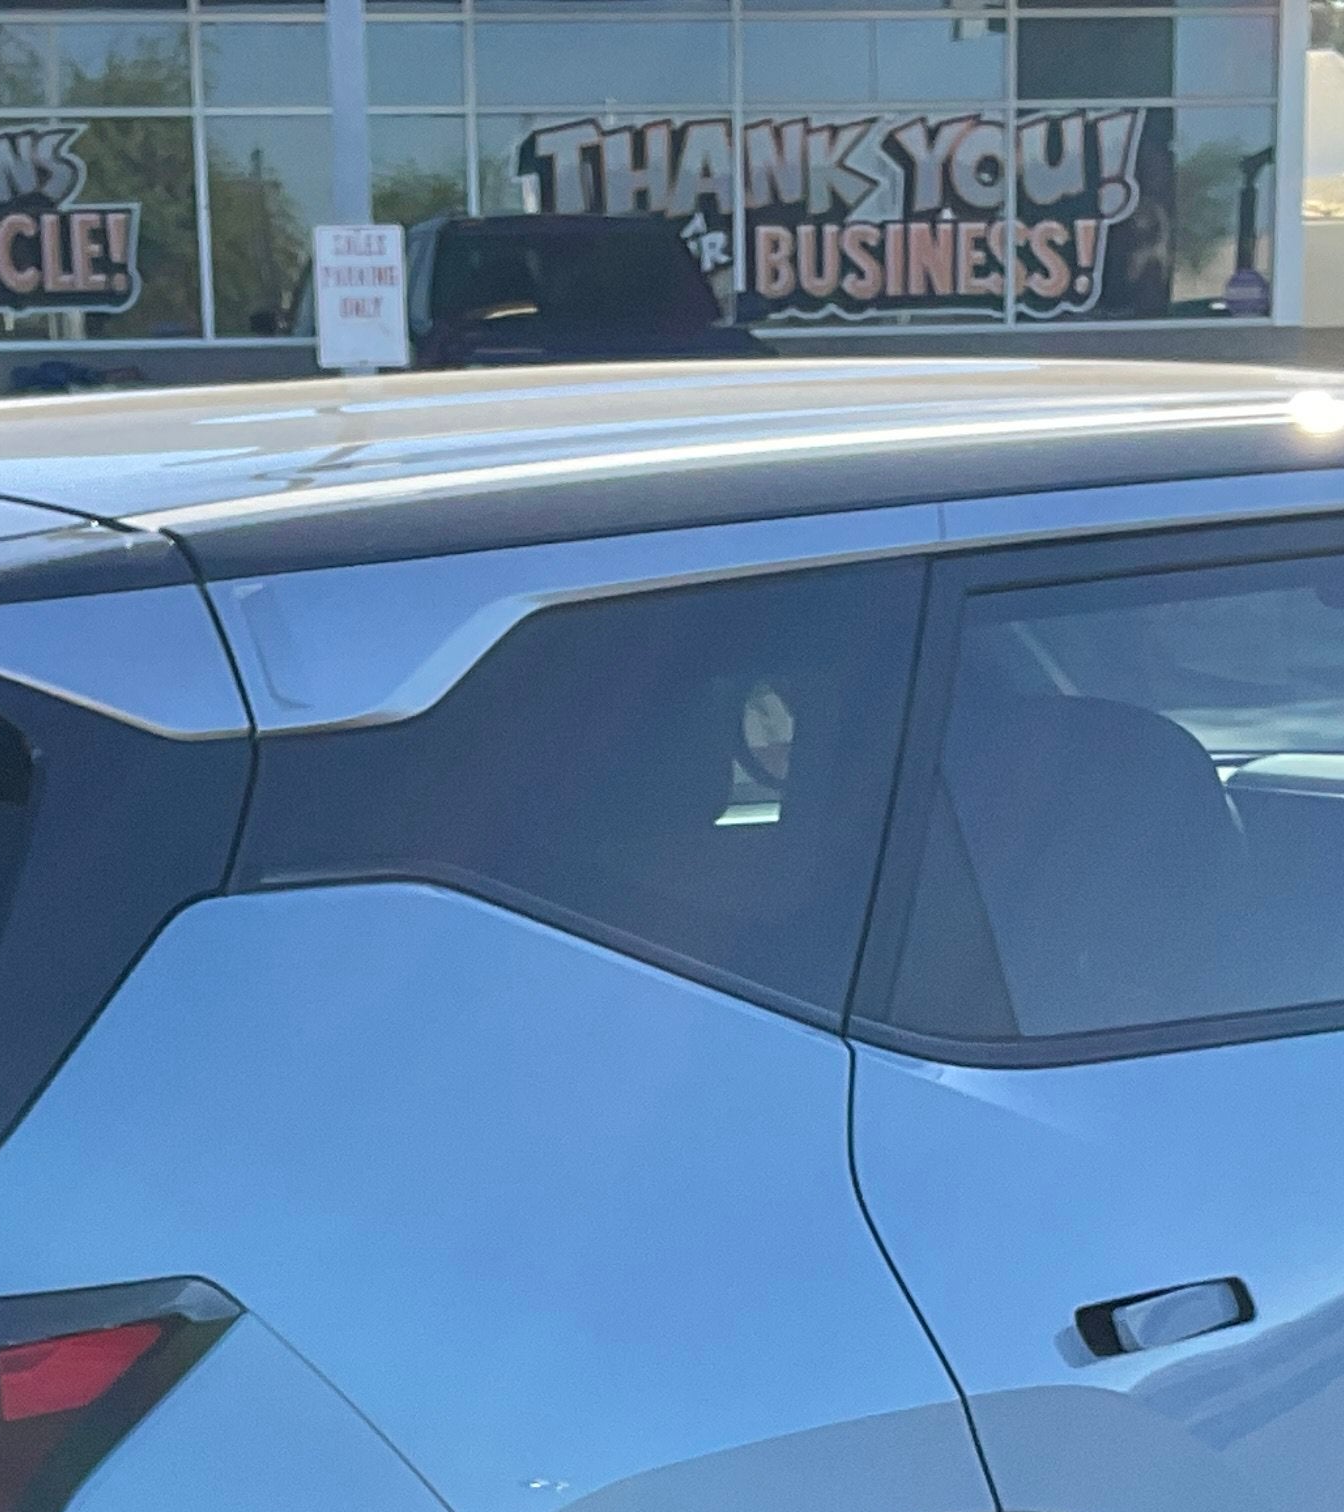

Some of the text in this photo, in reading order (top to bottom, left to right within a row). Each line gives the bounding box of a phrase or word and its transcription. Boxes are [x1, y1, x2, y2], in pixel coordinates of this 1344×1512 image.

[534, 110, 1134, 218] THANK YOU!
[755, 220, 1097, 299] BUSINESS!
